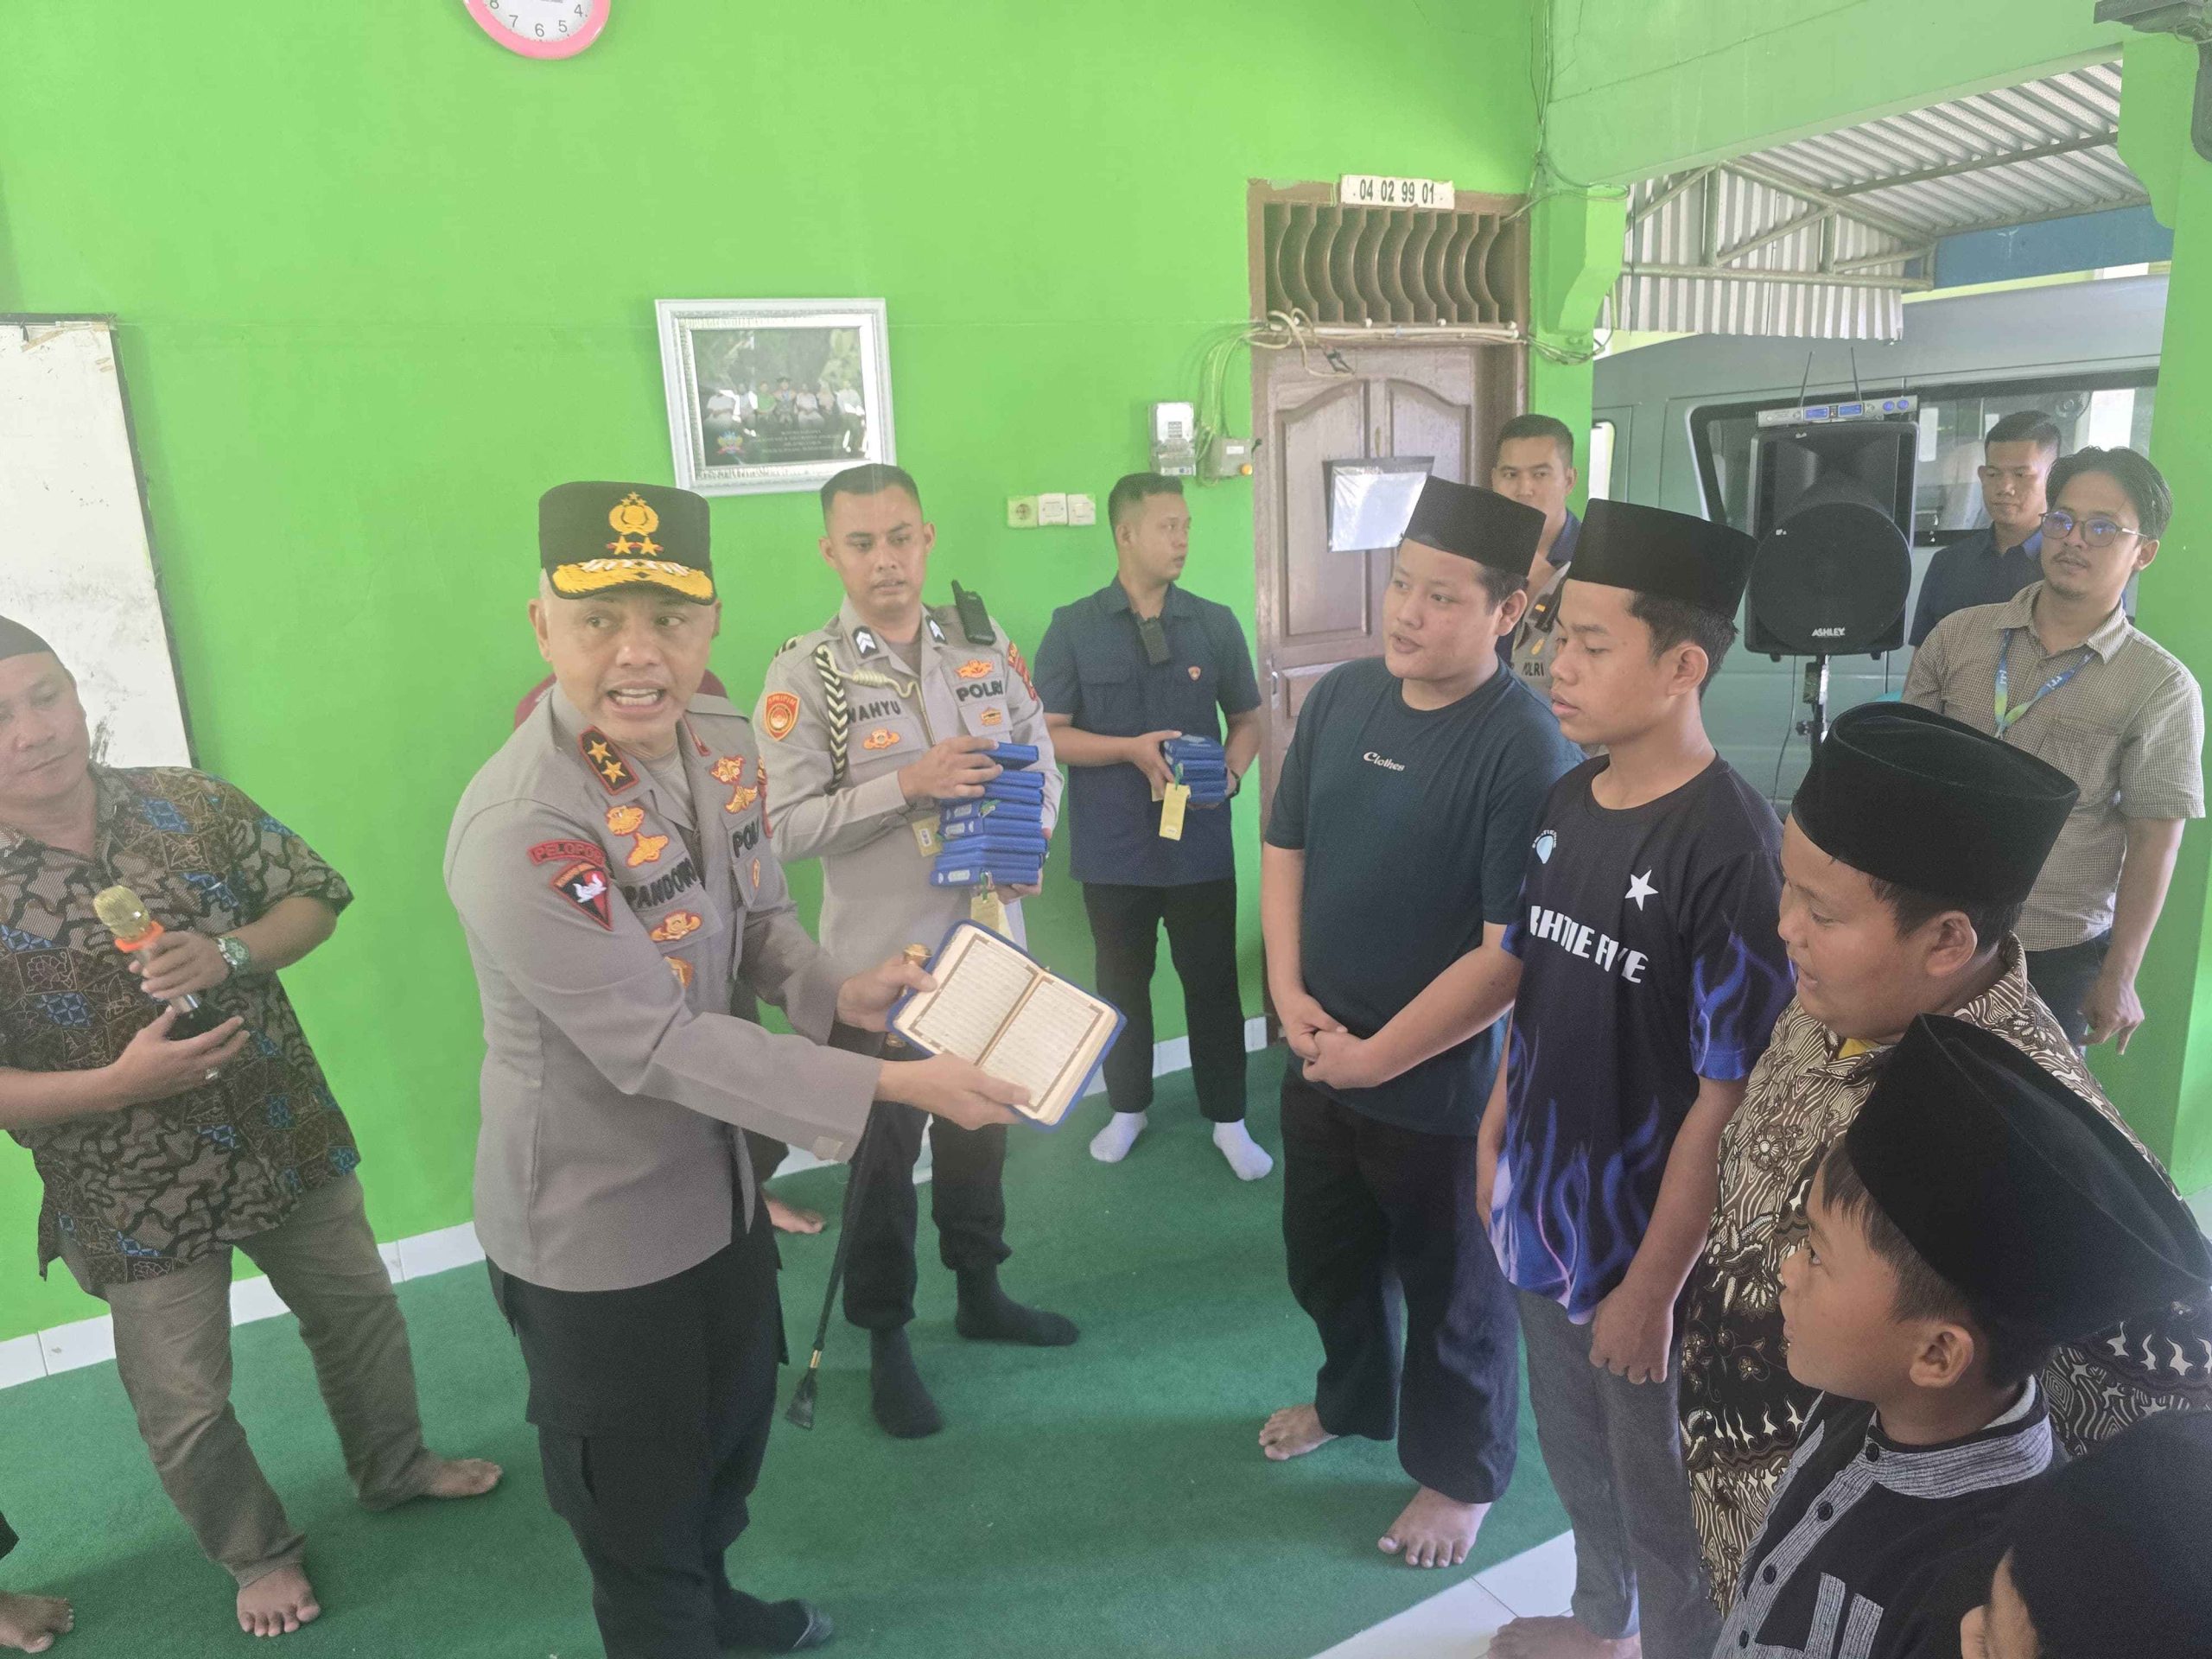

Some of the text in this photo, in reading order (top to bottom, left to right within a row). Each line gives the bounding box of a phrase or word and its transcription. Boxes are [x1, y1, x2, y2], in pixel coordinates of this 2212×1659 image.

[574, 4, 583, 17] 4
[509, 15, 518, 28] 7
[558, 20, 568, 33] 5
[535, 23, 545, 37] 6
[1360, 179, 1434, 205] 04 02 99 01
[1811, 626, 1846, 637] ASHLEY
[957, 680, 1003, 702] POLRI
[1363, 751, 1405, 772] Clothes
